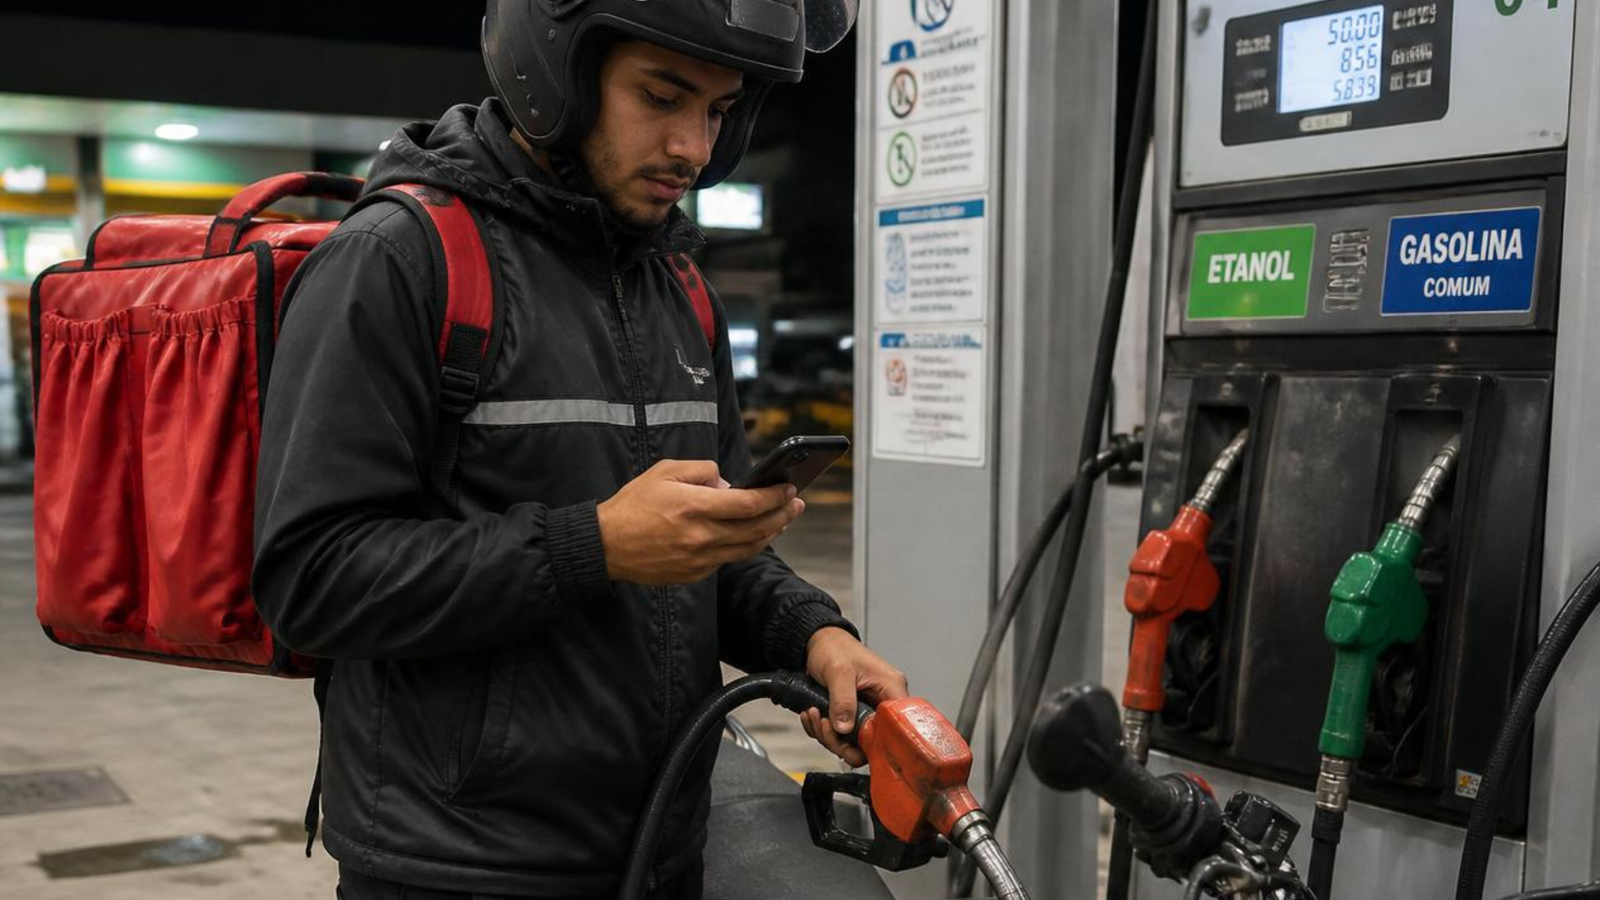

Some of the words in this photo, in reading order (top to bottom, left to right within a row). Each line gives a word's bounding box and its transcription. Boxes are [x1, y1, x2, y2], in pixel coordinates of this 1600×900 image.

[1327, 11, 1381, 46] 50.00
[1400, 228, 1523, 265] GASOLINA
[1207, 250, 1295, 284] ETANOL
[1423, 276, 1490, 298] COMUM
